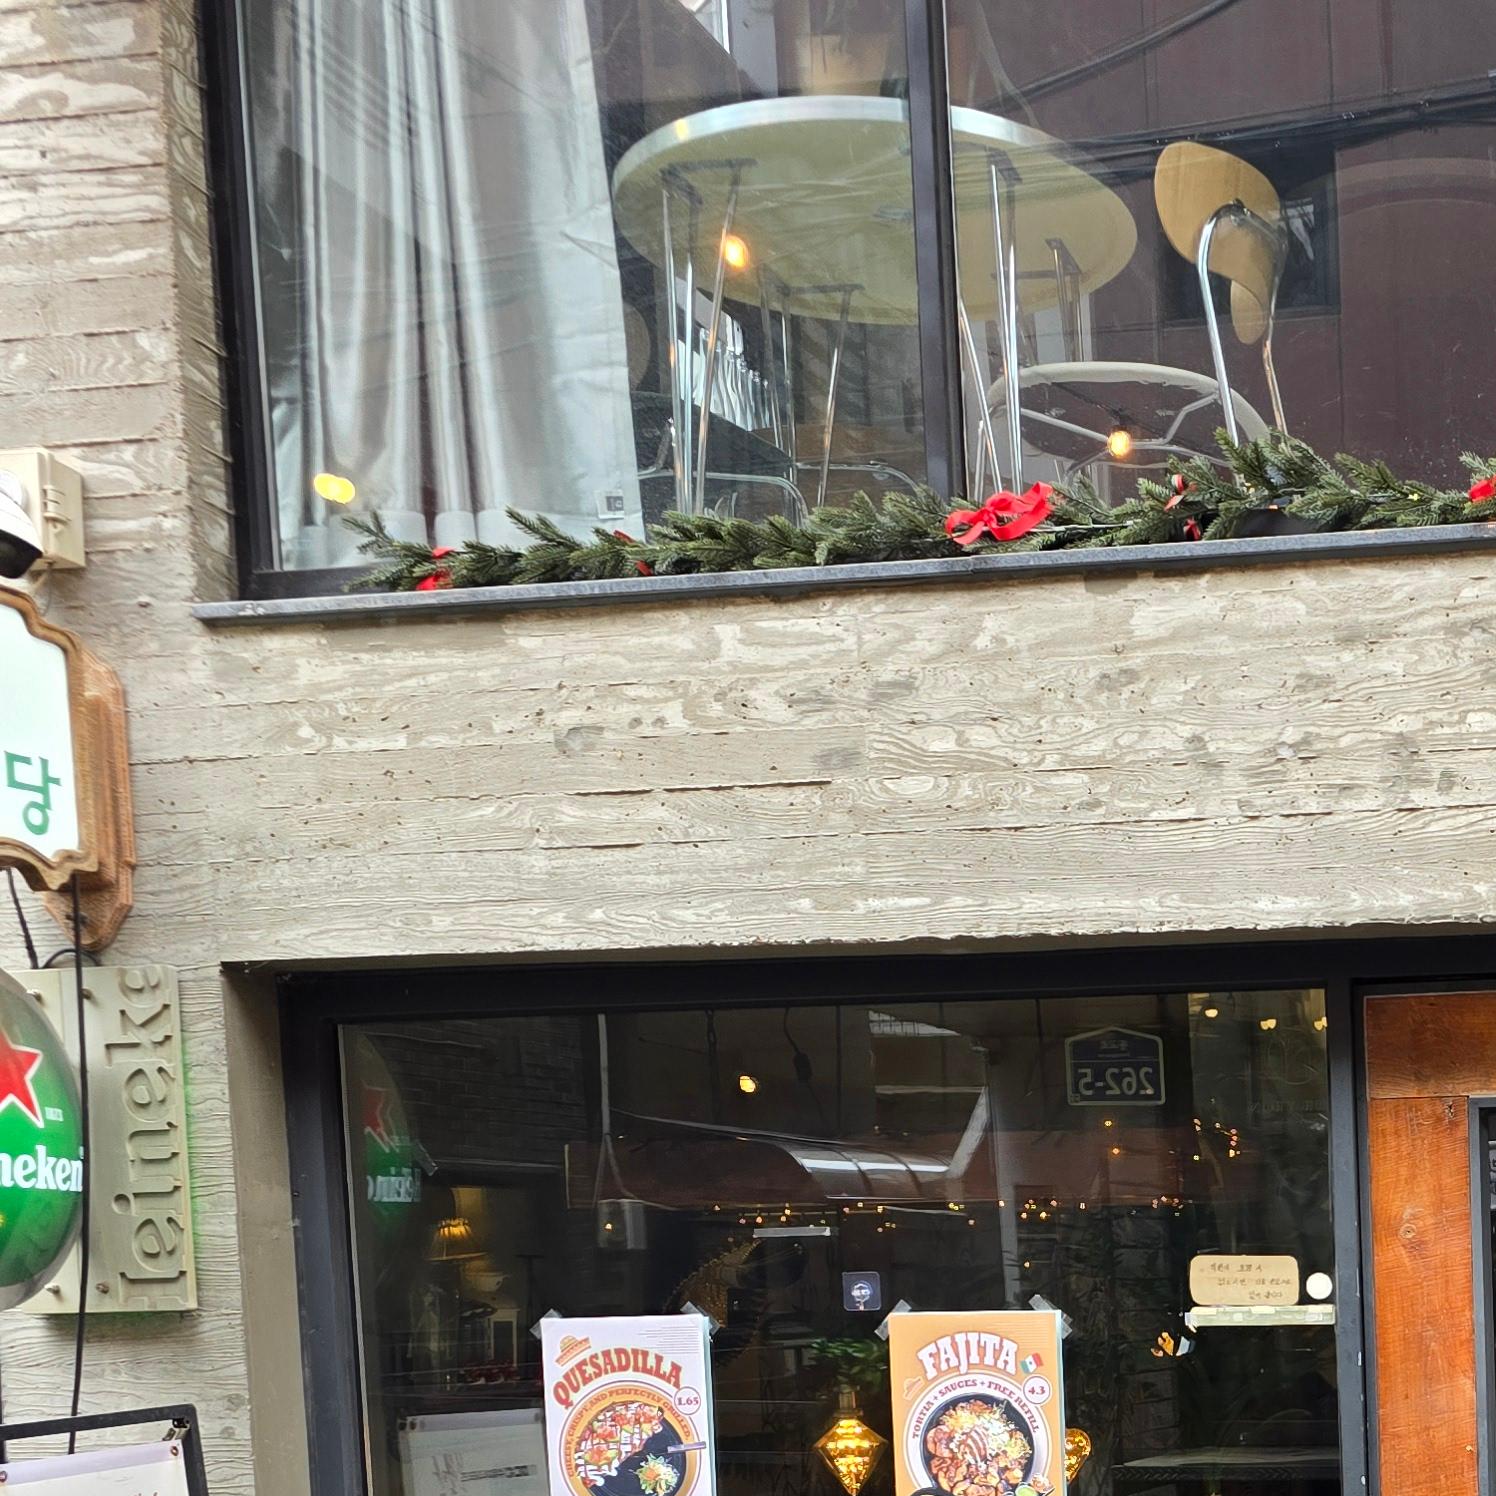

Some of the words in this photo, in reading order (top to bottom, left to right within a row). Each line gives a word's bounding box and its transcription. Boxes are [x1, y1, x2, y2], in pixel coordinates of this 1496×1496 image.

[5, 750, 61, 836] 당
[553, 1347, 683, 1410] QUESADILLA
[917, 1332, 1018, 1380] FAJITA
[590, 1393, 608, 1407] AND
[608, 1388, 664, 1404] PERFECTLY
[677, 1396, 699, 1406] 1.65
[938, 1379, 978, 1397] SAUCES
[987, 1381, 1016, 1399] FREE
[1014, 1396, 1039, 1433] REFILL
[1028, 1385, 1046, 1395] 4.3
